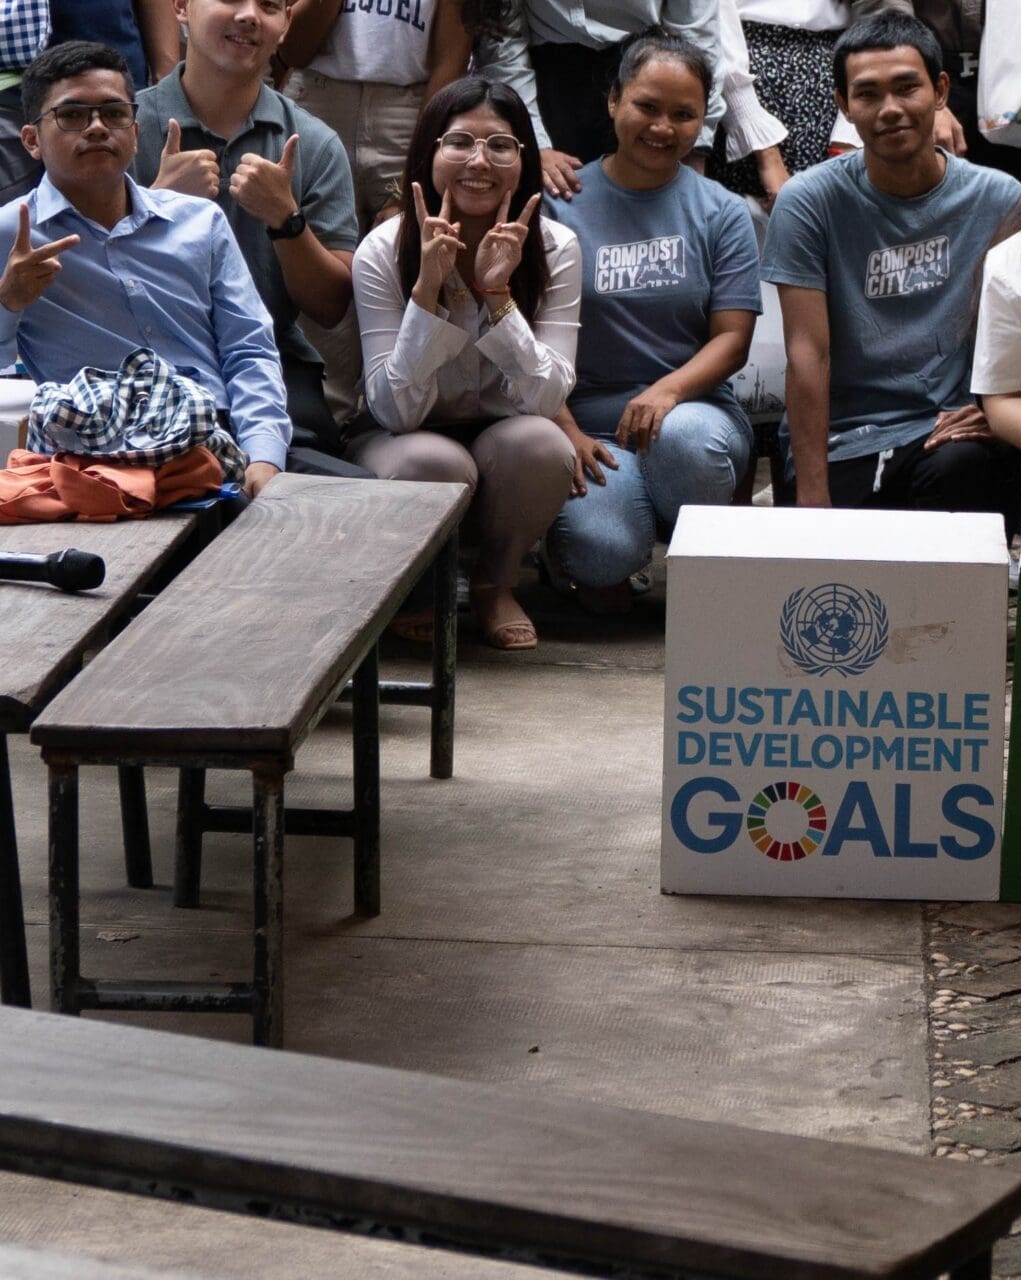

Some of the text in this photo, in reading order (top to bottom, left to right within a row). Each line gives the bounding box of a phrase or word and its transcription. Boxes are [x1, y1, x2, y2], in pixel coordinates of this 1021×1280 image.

[598, 238, 680, 270] COMPOST
[869, 238, 946, 275] COMPOST
[597, 265, 640, 292] CITY
[867, 269, 906, 297] CITY
[676, 686, 991, 731] SUSTAINABLE
[676, 731, 989, 772] DEVELOPMENT
[670, 775, 996, 862] GOALS
